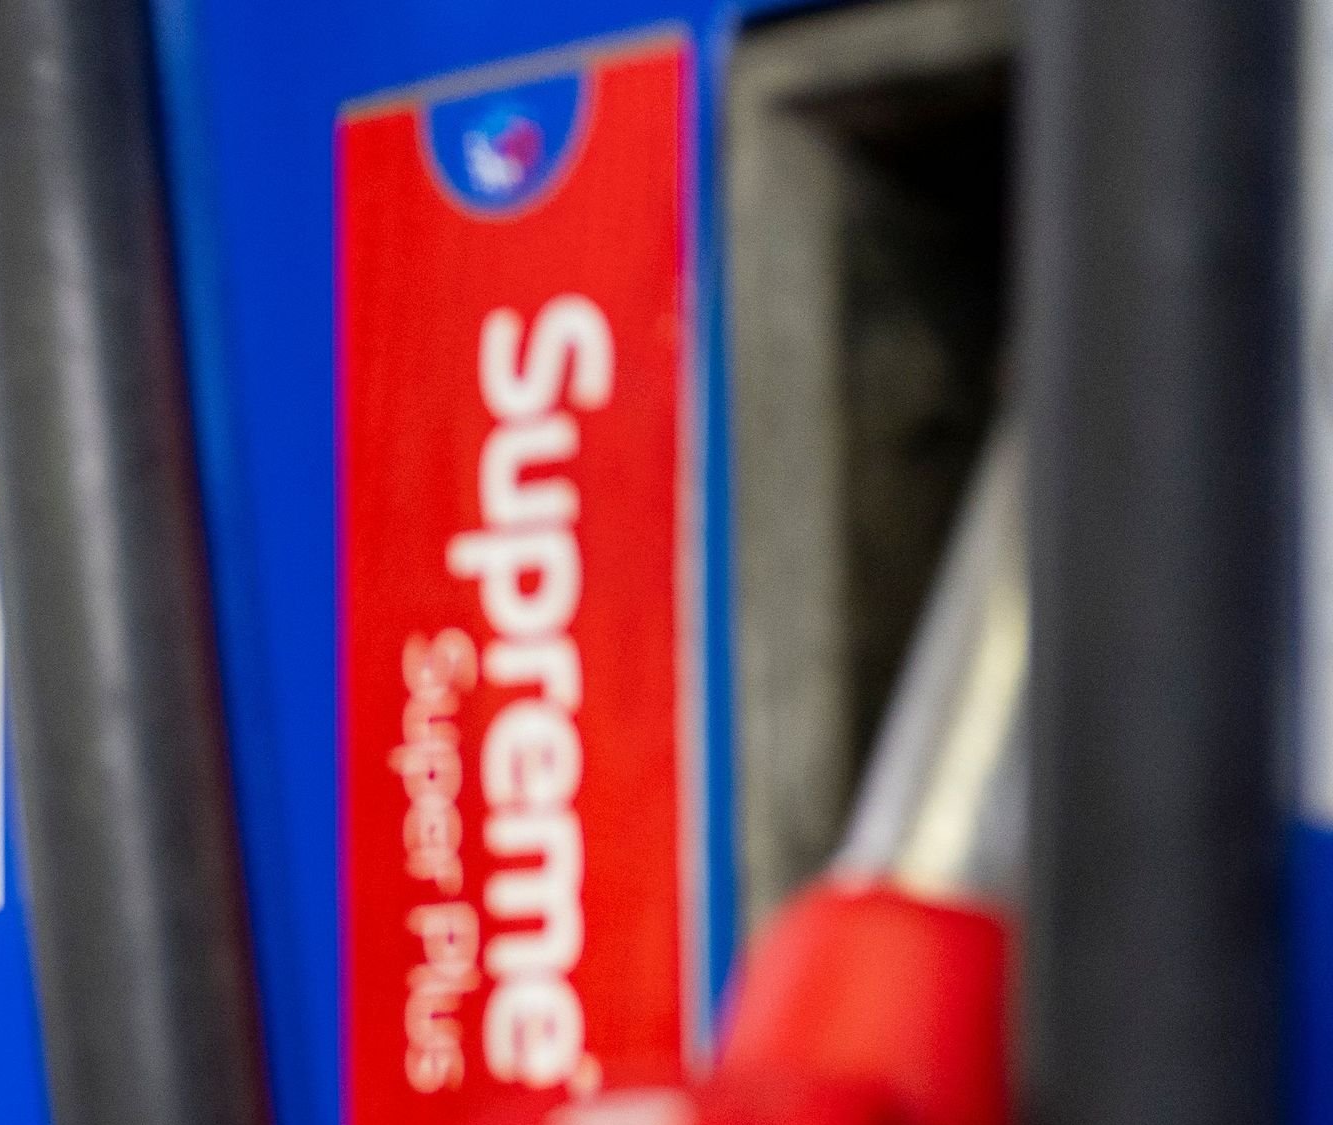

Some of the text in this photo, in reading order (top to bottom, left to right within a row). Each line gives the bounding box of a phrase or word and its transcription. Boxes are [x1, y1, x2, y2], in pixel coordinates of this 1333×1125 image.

[388, 627, 482, 1094] Super Plus
[445, 293, 615, 1089] Supreme
